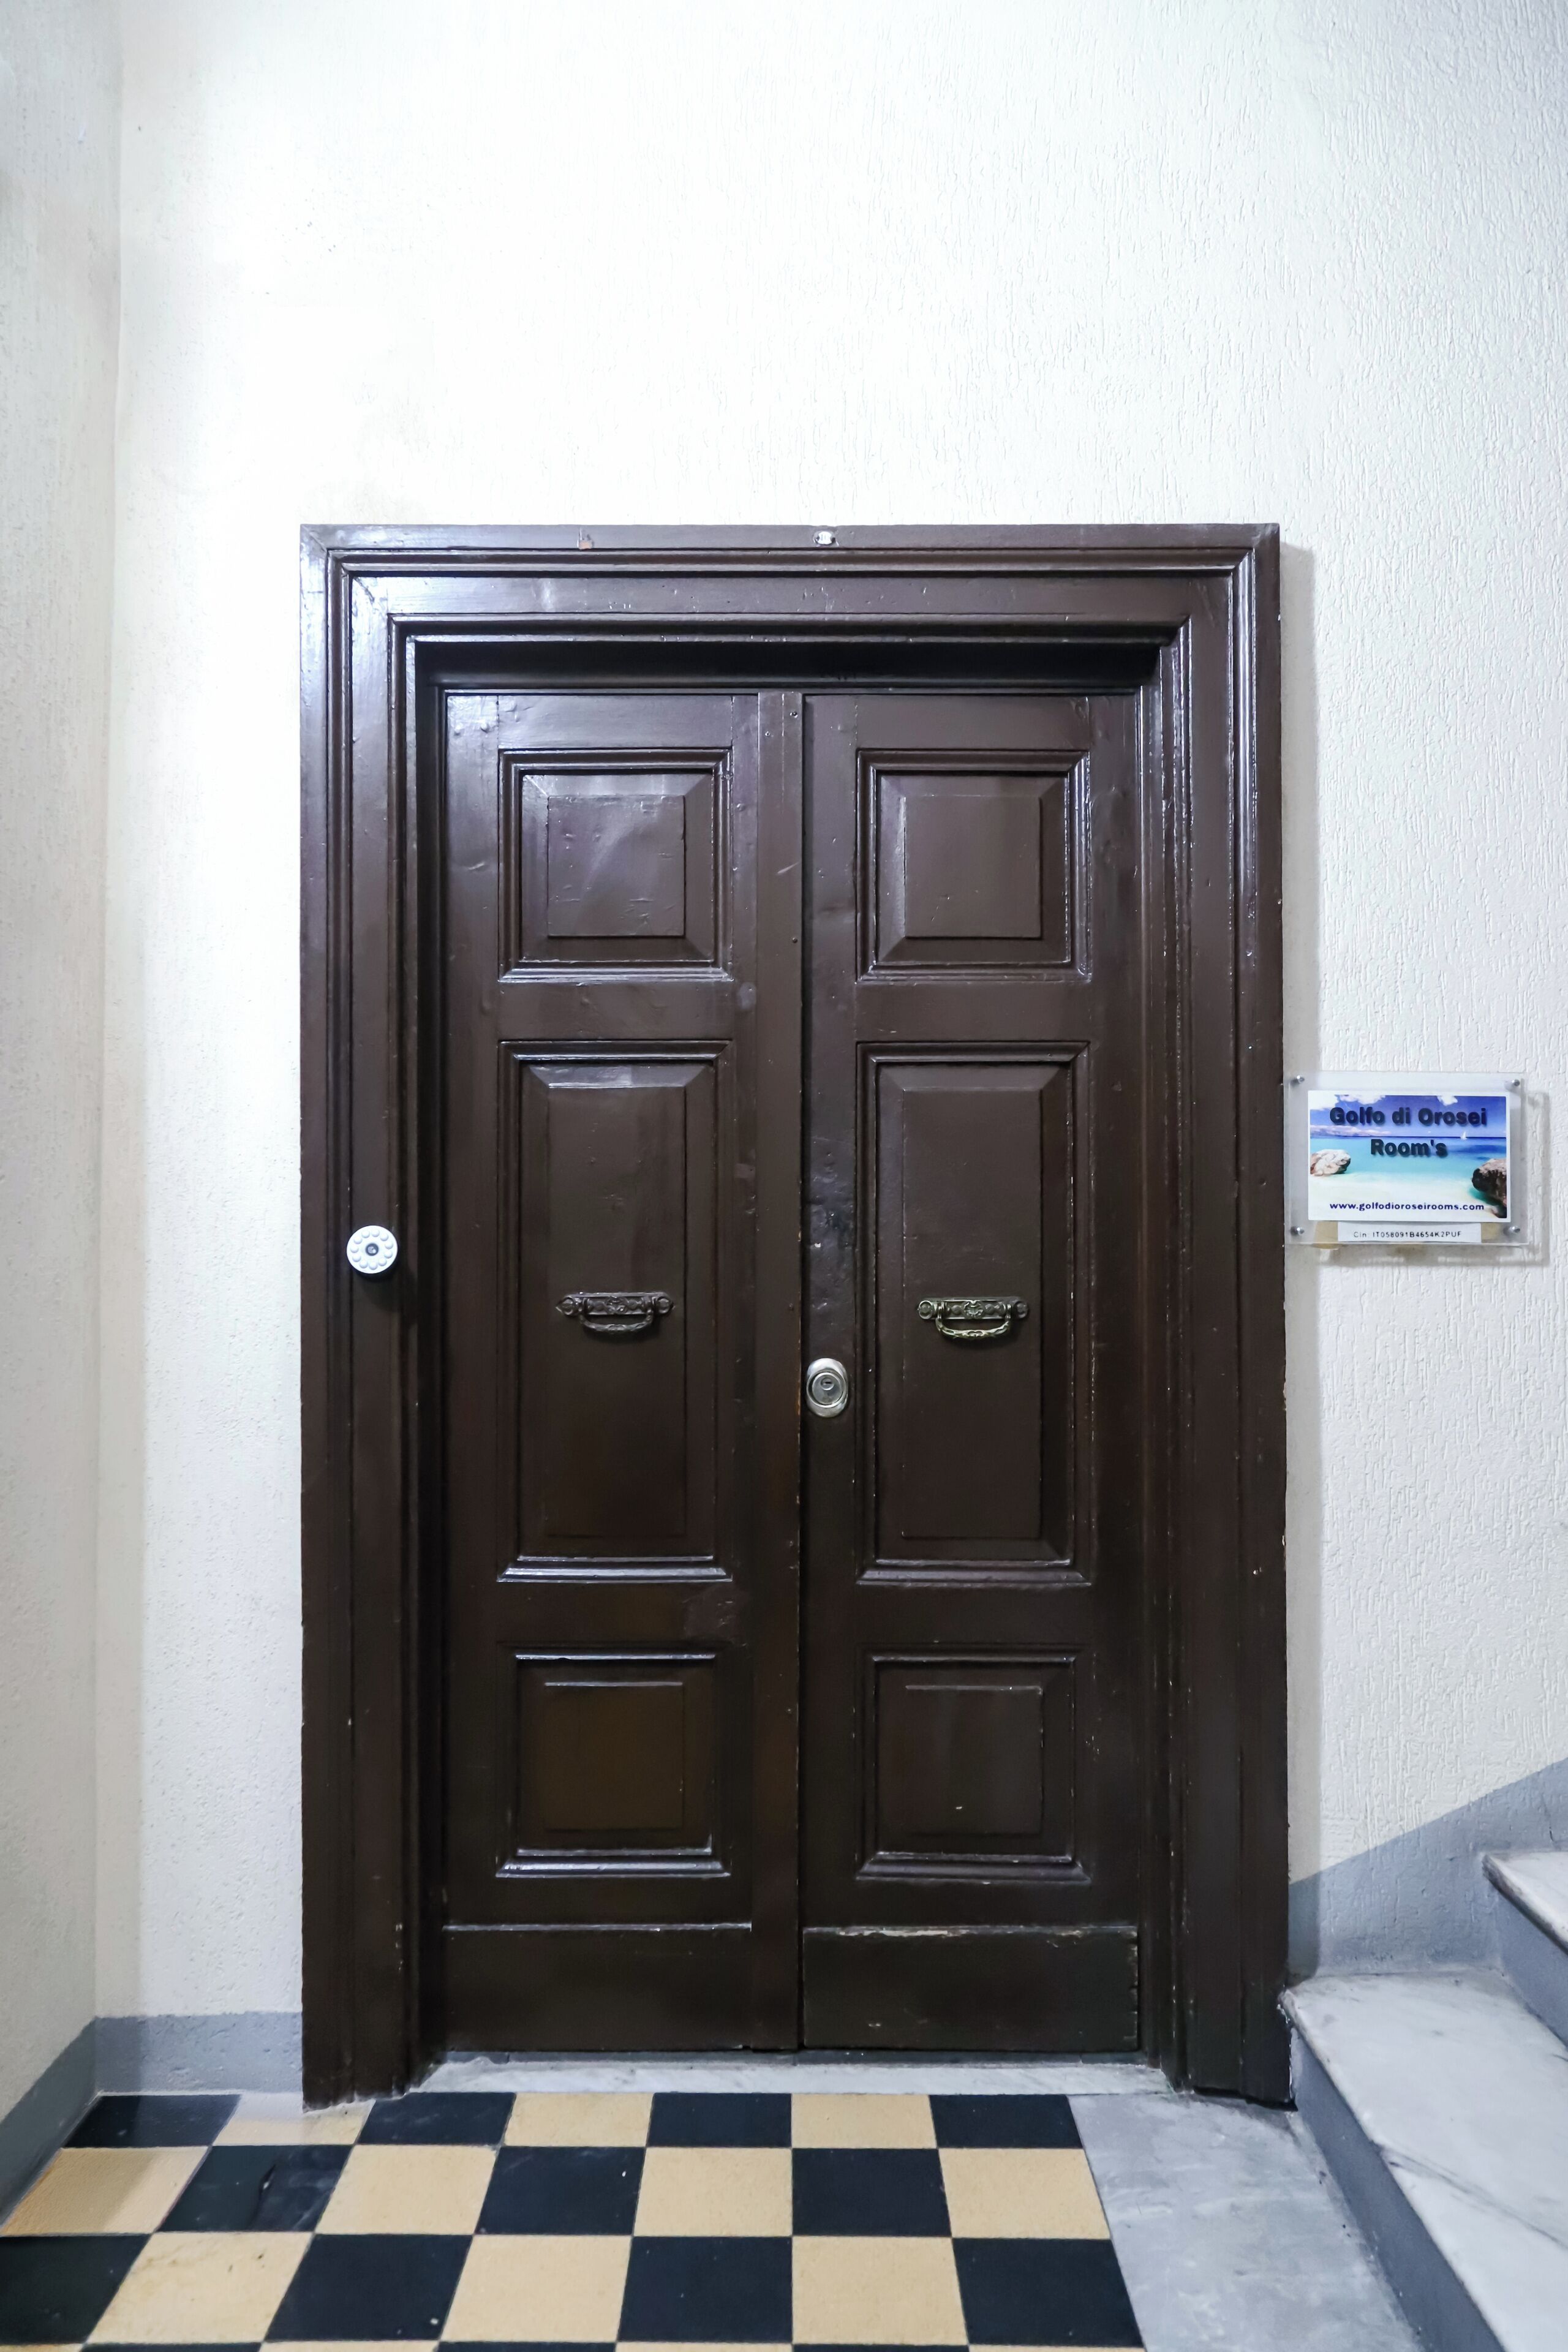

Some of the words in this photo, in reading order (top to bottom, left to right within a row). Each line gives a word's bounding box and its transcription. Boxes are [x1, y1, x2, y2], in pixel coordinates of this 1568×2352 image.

[1330, 1107, 1385, 1126] Golfo
[1392, 1107, 1411, 1126] di
[1418, 1107, 1488, 1126] Orosei
[1371, 1139, 1448, 1157] Room's
[1330, 1201, 1485, 1211] www.golfodioroseirooms.com
